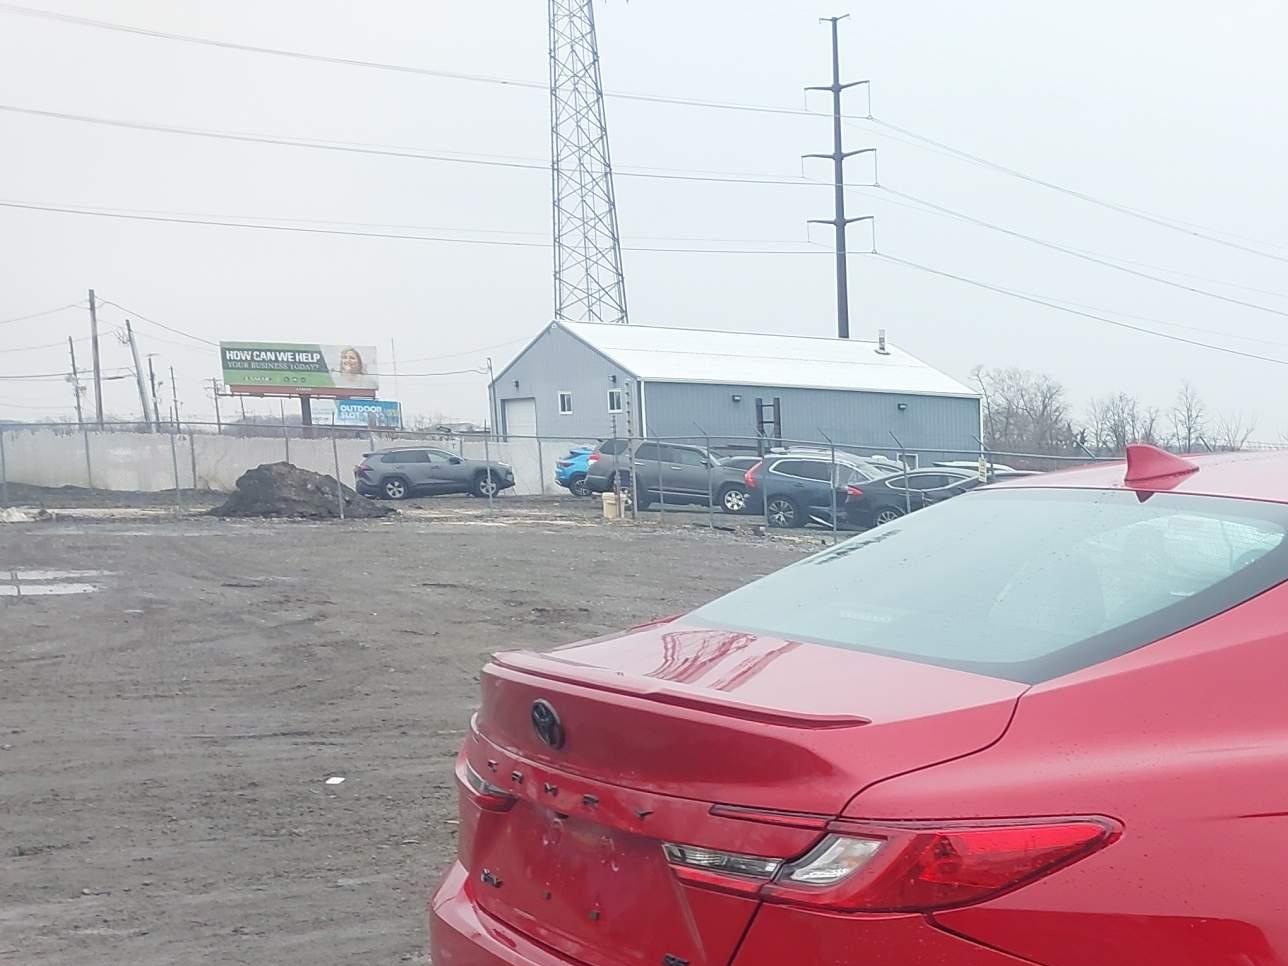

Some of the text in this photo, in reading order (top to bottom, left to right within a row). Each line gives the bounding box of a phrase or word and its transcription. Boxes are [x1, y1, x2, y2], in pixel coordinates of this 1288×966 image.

[226, 350, 321, 363] HOW CAN WE HELP
[227, 361, 249, 369] YOUR
[251, 362, 289, 370] BUSINESS
[340, 404, 382, 413] OUTDOOR
